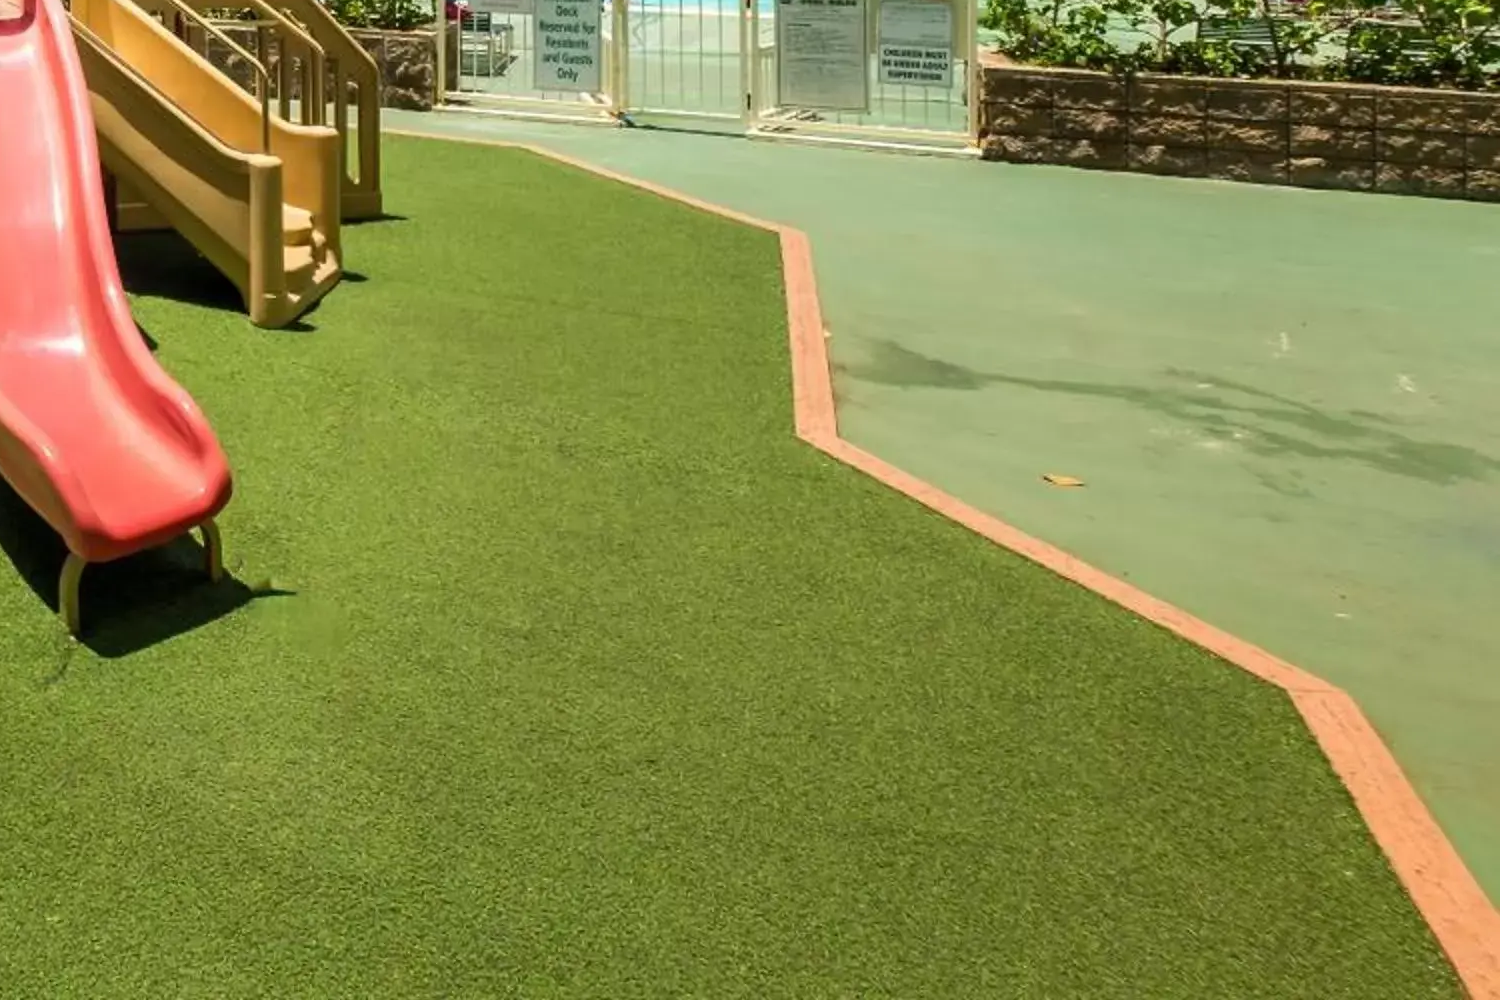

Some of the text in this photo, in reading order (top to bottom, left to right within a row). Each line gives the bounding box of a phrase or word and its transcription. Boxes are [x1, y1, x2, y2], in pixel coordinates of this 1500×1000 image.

[540, 19, 580, 33] Reserved
[562, 53, 593, 65] Guests
[557, 67, 578, 82] Only
